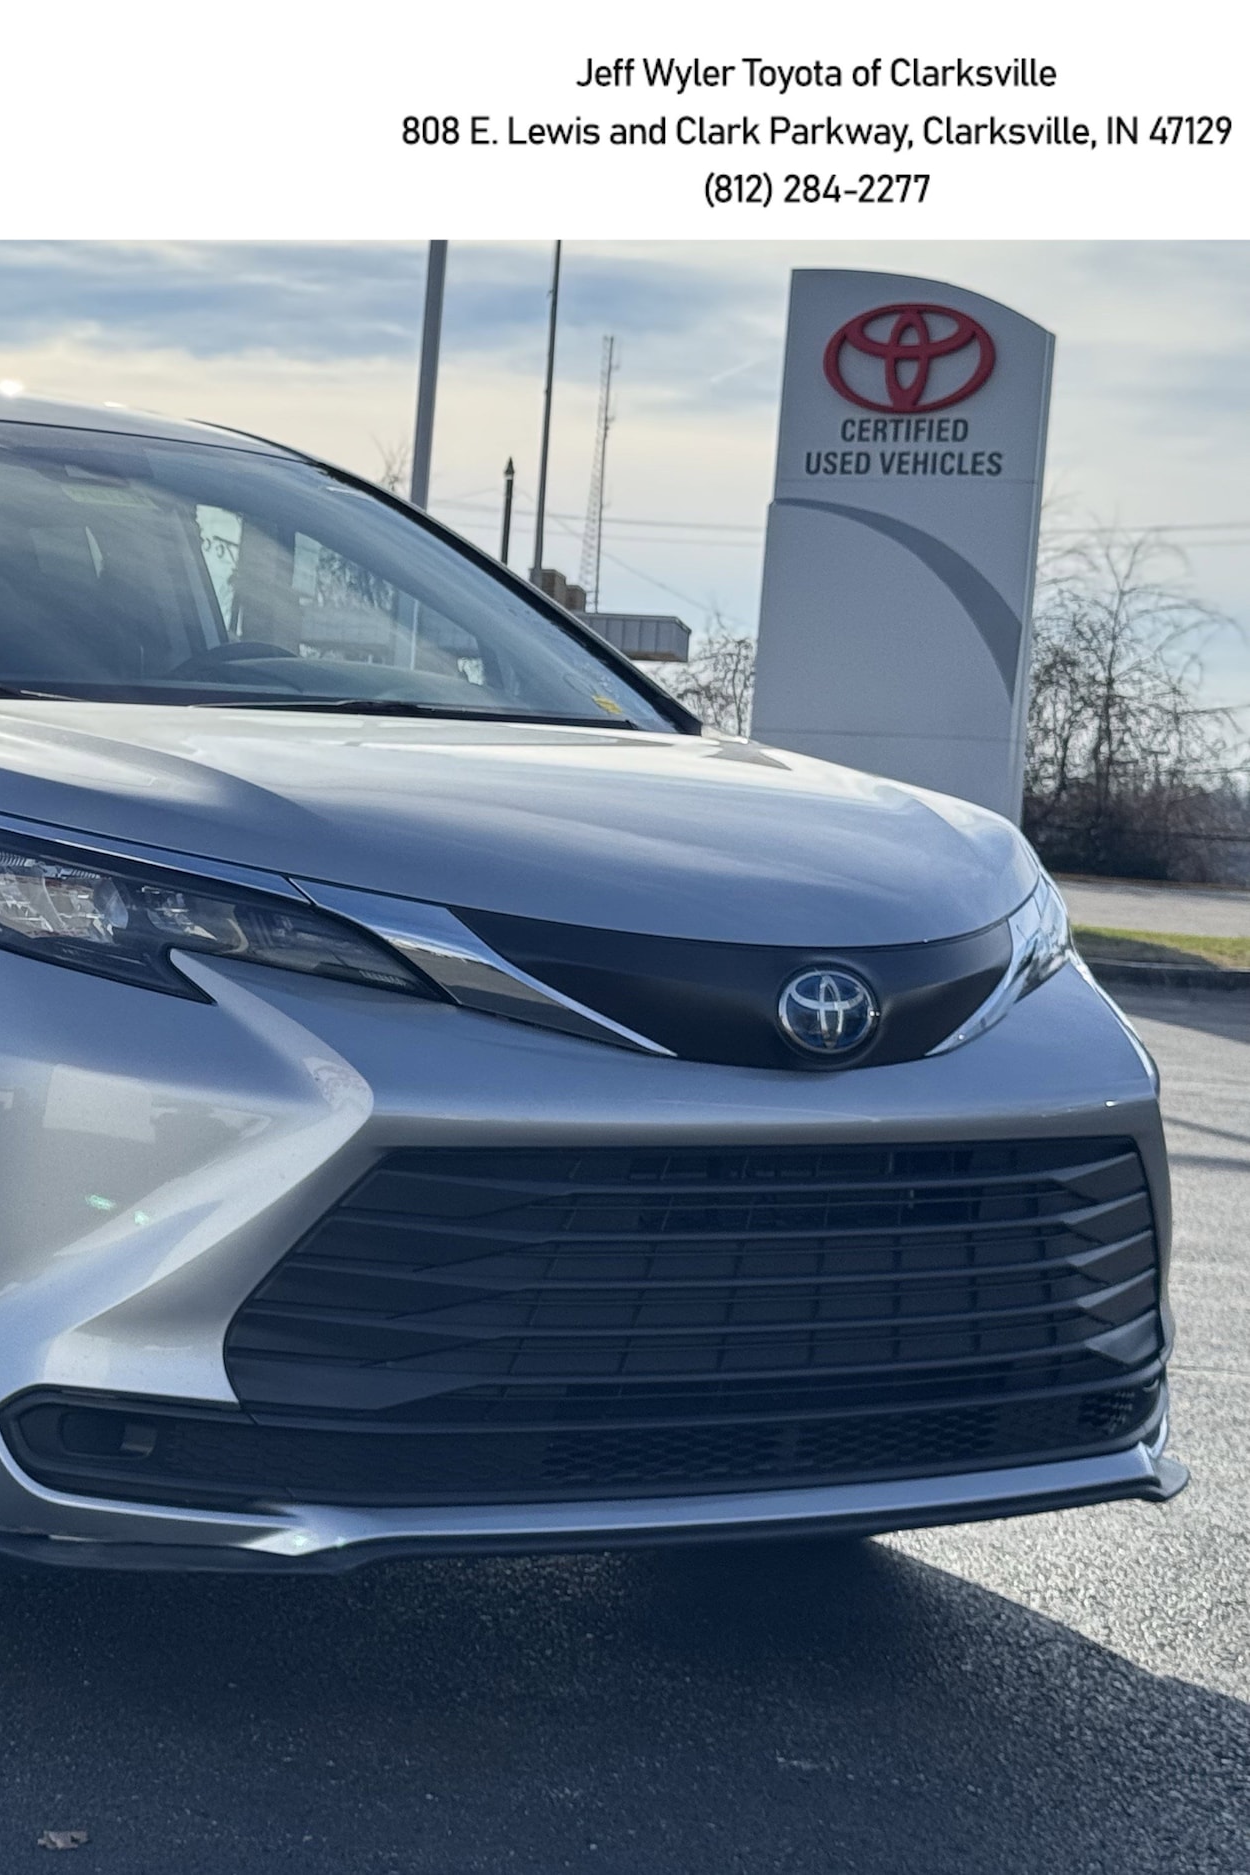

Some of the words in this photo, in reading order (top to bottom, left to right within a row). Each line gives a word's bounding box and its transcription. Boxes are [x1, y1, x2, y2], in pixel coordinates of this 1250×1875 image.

[840, 418, 969, 443] CERTIFIED
[805, 451, 871, 475] USED
[879, 451, 1003, 476] VEHICLES
